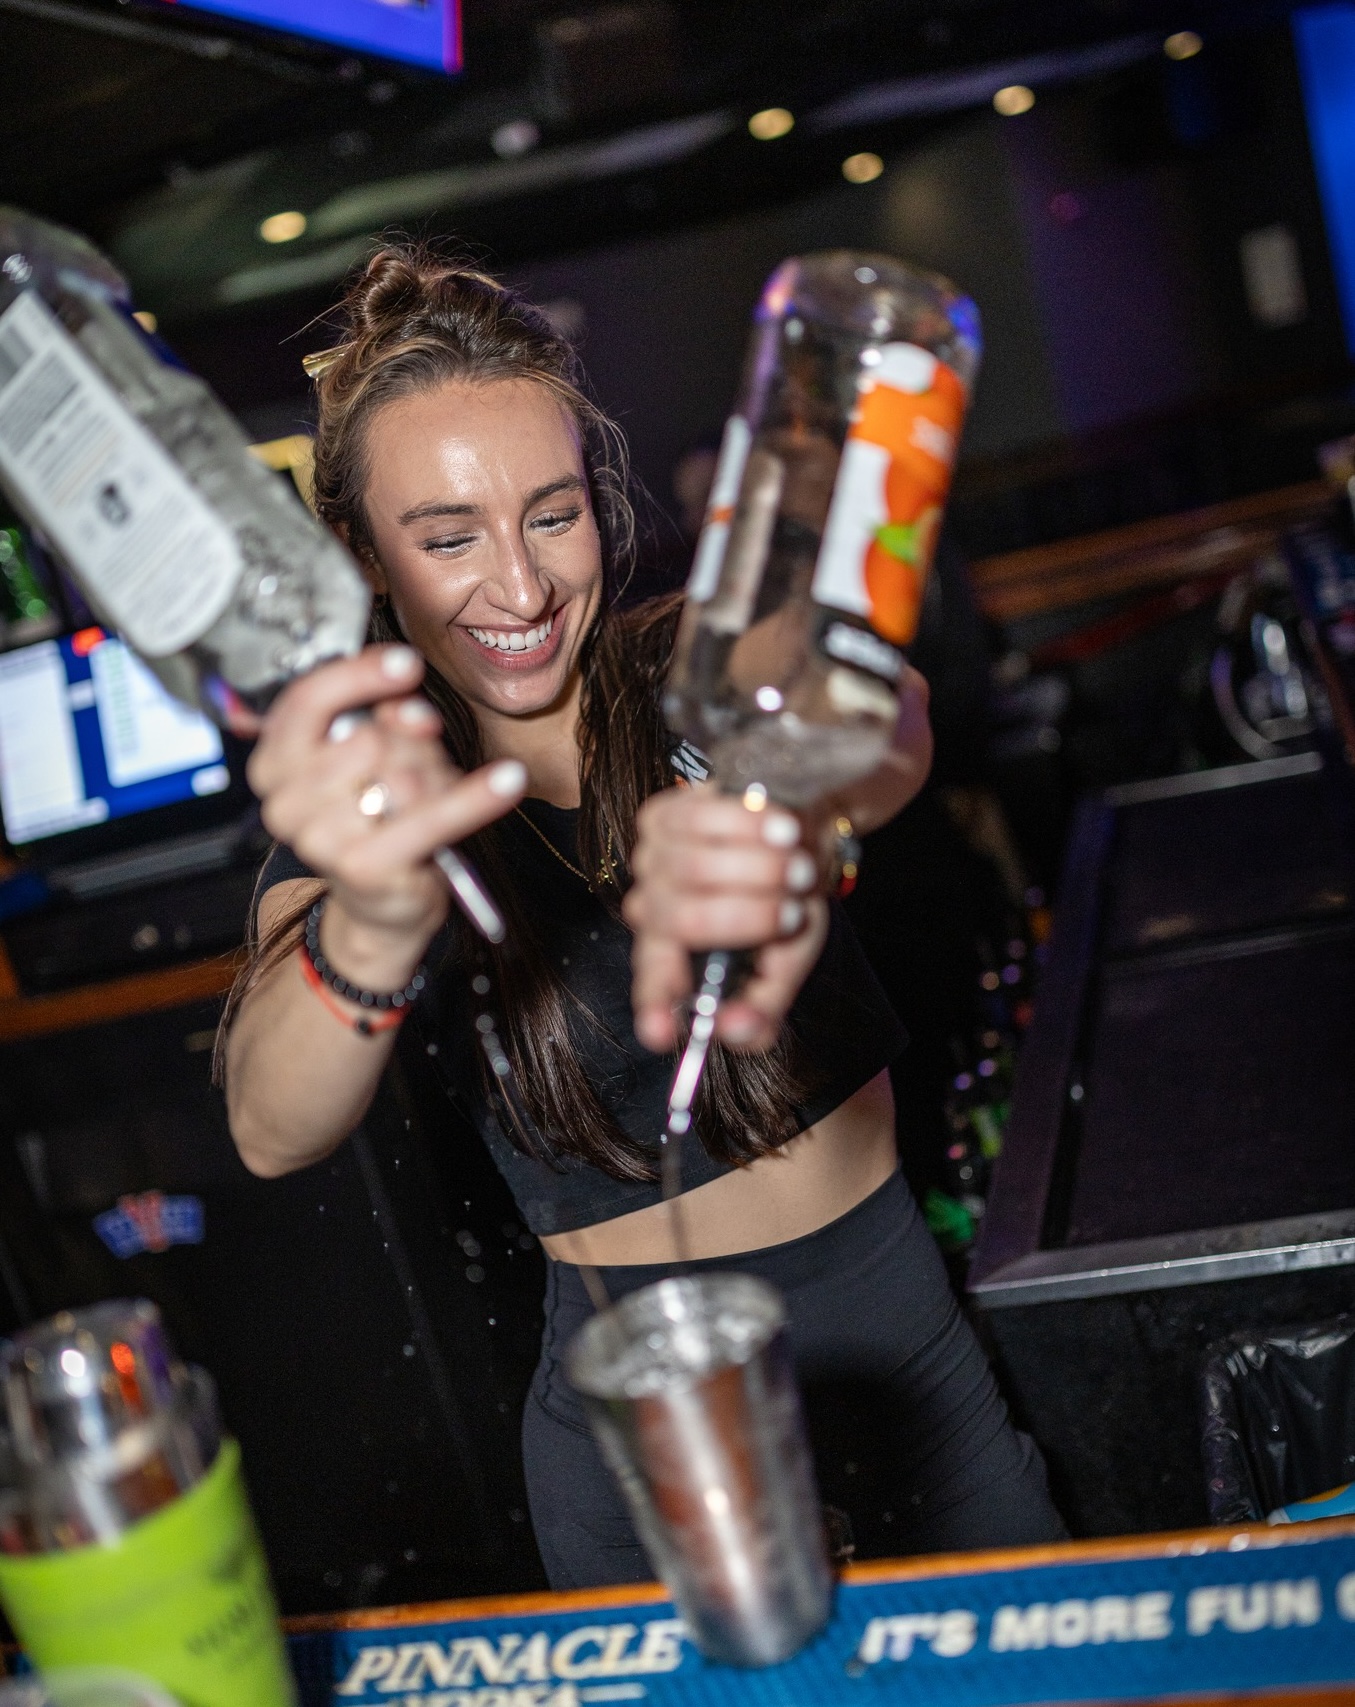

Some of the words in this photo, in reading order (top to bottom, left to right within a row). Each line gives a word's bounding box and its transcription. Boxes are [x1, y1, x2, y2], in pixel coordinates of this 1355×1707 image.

[335, 1620, 685, 1695] PINNACLE
[858, 1609, 978, 1664] IT'S
[988, 1590, 1174, 1653] MORE
[1186, 1577, 1322, 1636] FUN
